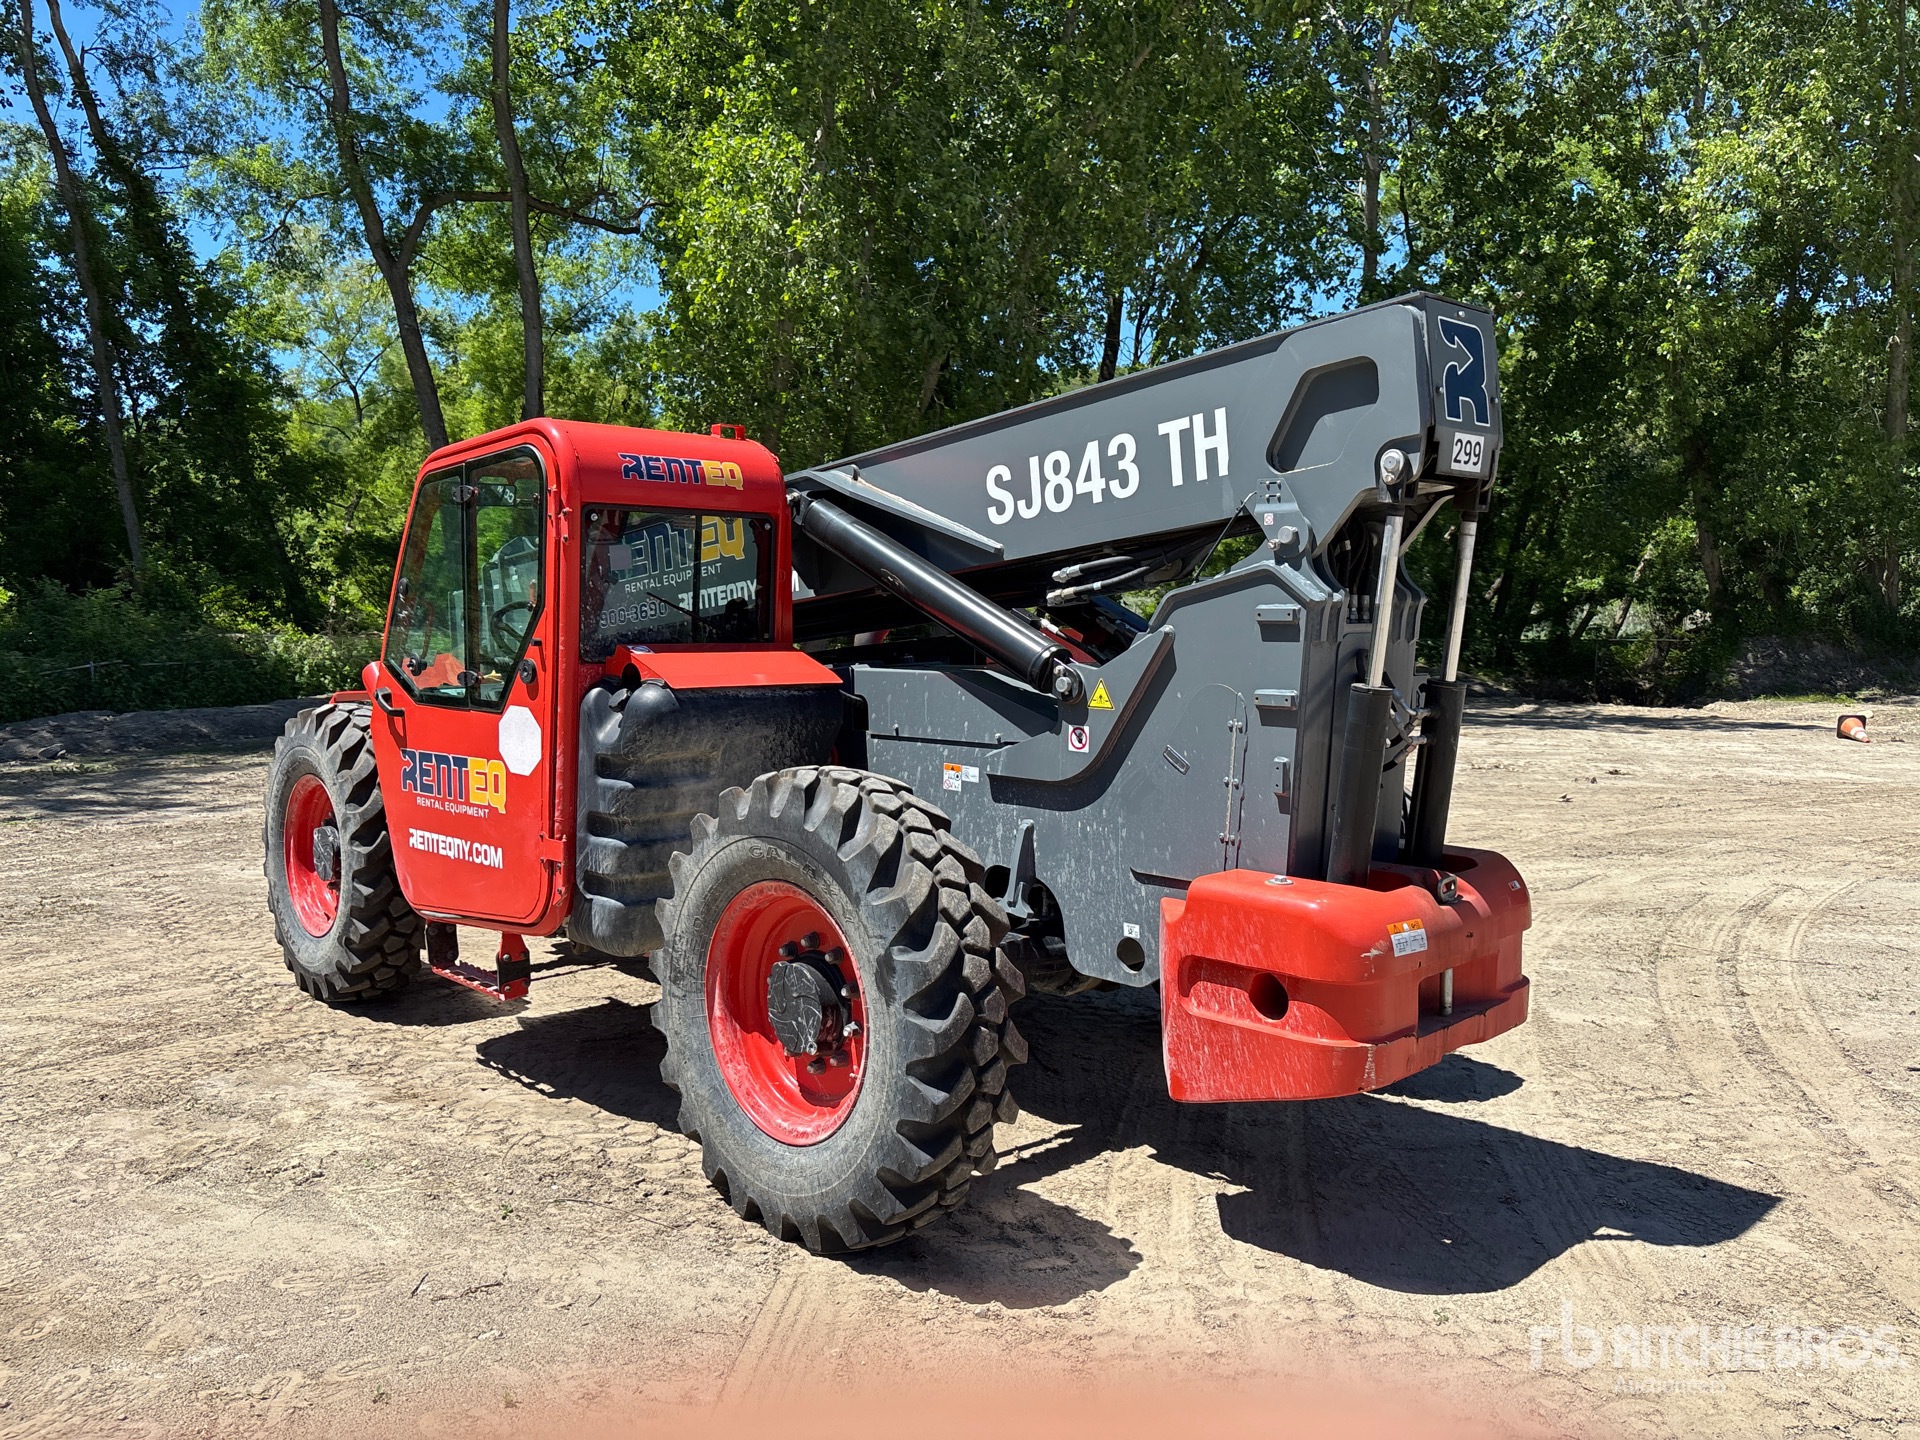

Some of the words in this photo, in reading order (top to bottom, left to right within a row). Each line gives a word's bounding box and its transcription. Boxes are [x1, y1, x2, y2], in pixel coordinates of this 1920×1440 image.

[617, 452, 744, 491] RENTEQ
[985, 432, 1140, 526] SJ843
[1157, 406, 1230, 488] TH
[1453, 438, 1482, 467] 299
[624, 578, 662, 594] RENTAL
[663, 562, 723, 588] EQUIPENT
[400, 747, 507, 814] RENTEQ
[416, 796, 444, 811] RENTAL
[444, 802, 490, 819] EQUIPMENT
[408, 827, 504, 870] RENTEQNY.COM
